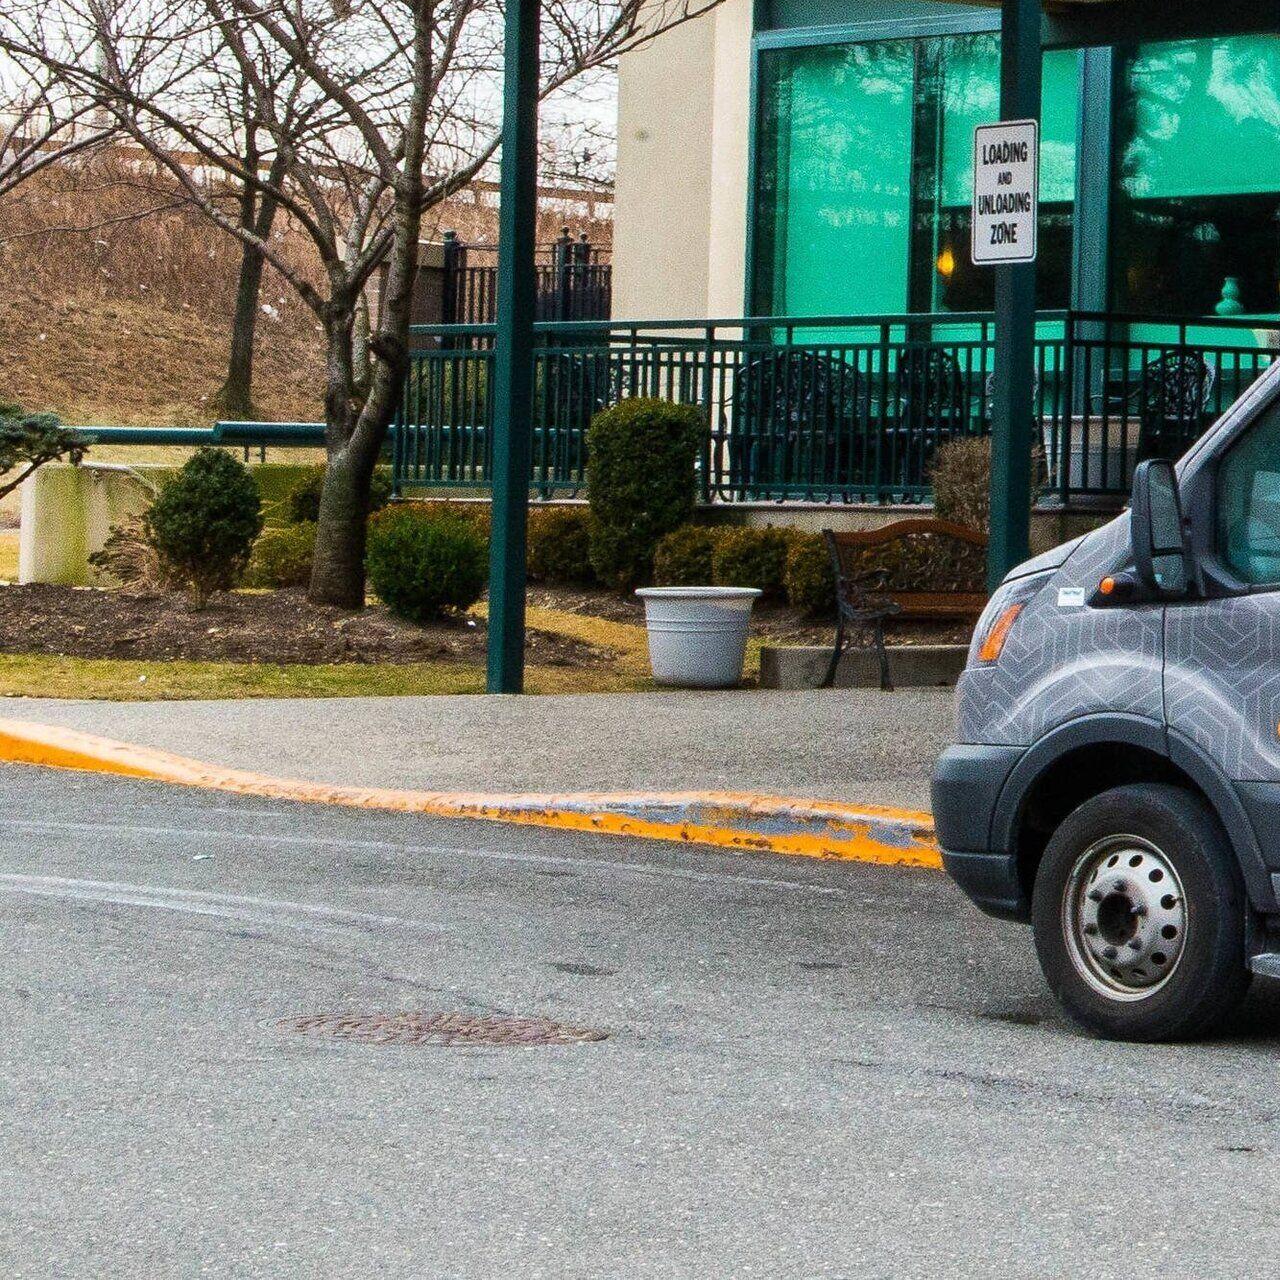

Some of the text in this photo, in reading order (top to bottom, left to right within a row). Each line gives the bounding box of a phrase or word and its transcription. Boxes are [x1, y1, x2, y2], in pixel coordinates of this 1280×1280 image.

[982, 141, 1028, 166] LOADING
[997, 171, 1013, 186] AND
[978, 191, 1031, 216] UNLOADING
[990, 221, 1018, 245] ZONE
